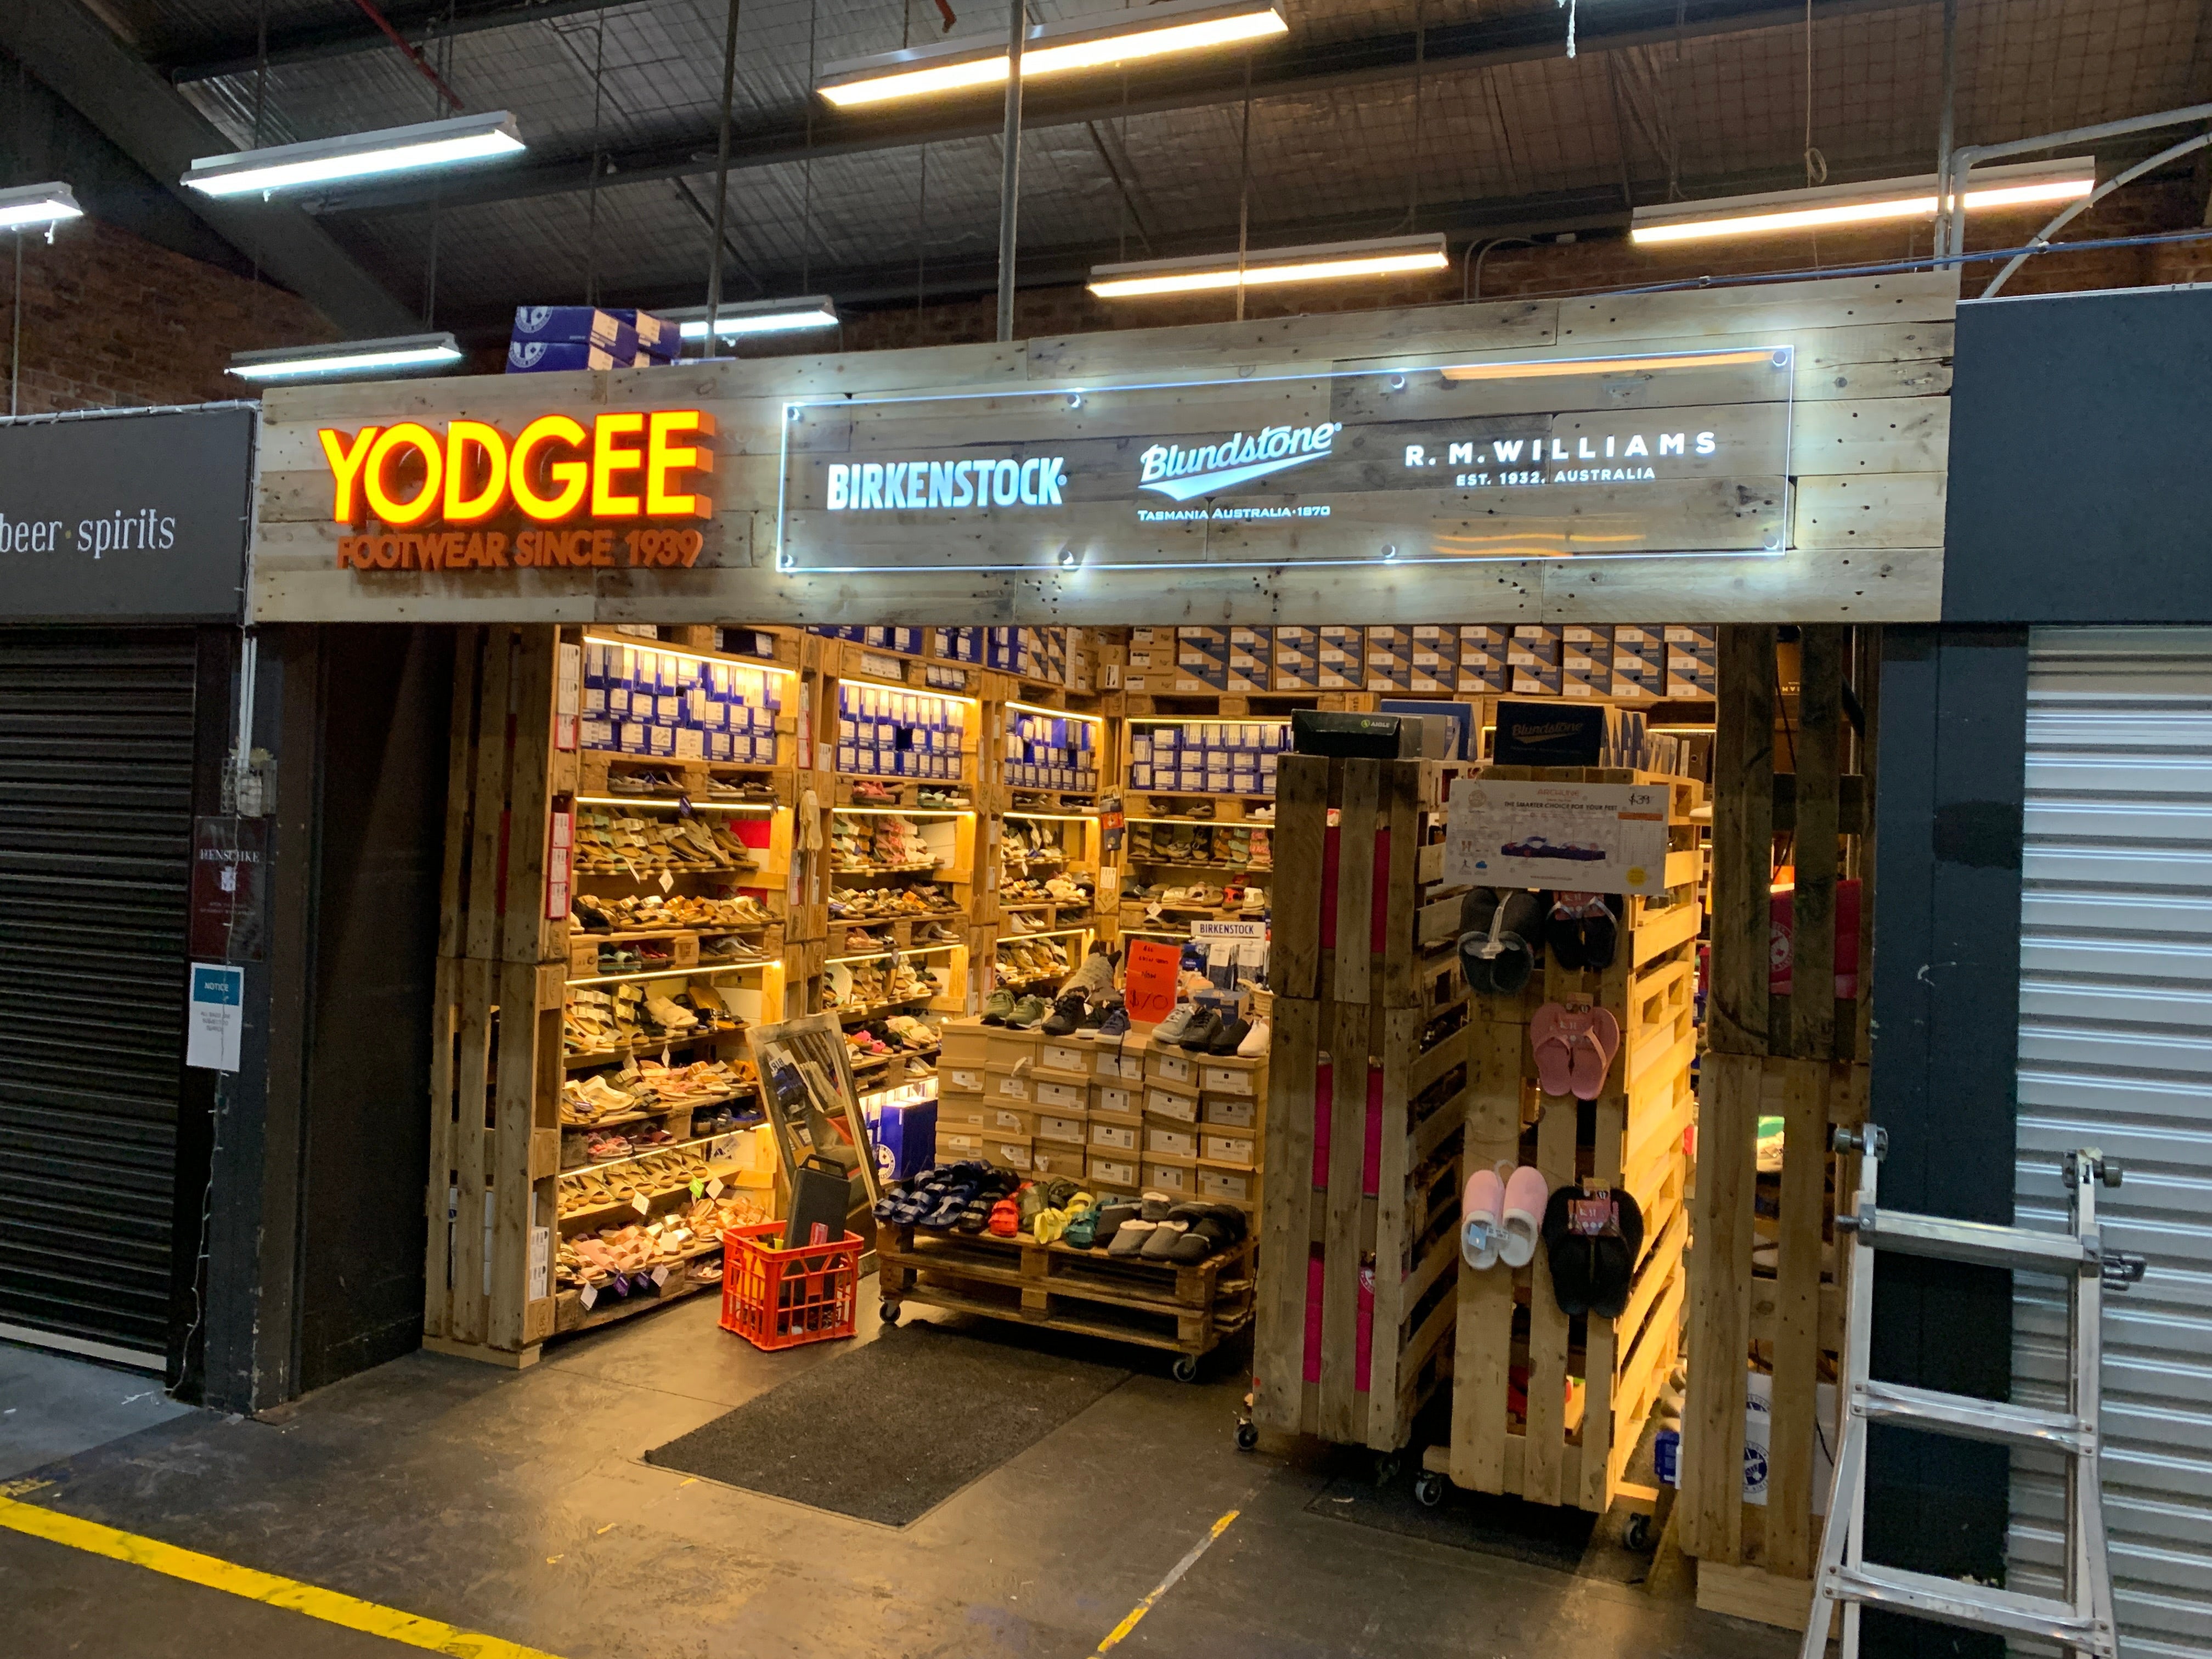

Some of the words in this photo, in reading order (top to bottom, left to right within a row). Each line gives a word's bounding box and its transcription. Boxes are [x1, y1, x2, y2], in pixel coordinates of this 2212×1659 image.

[318, 410, 710, 524] YODGEE
[1139, 422, 1333, 484] Blundstone
[827, 456, 1064, 510] BIRKENSTOCK
[1456, 473, 1492, 487] EST.
[1554, 467, 1656, 483] AUSTRALIA
[0, 512, 63, 553] beer
[77, 508, 176, 560] spirits
[1137, 510, 1209, 521] TASMANIA
[337, 531, 509, 571] FOOTWEAR
[515, 530, 616, 567] SINCE
[625, 529, 703, 567] 1939
[1200, 923, 1254, 934] BIRKENSTOCK
[204, 982, 229, 992] NOTICE
